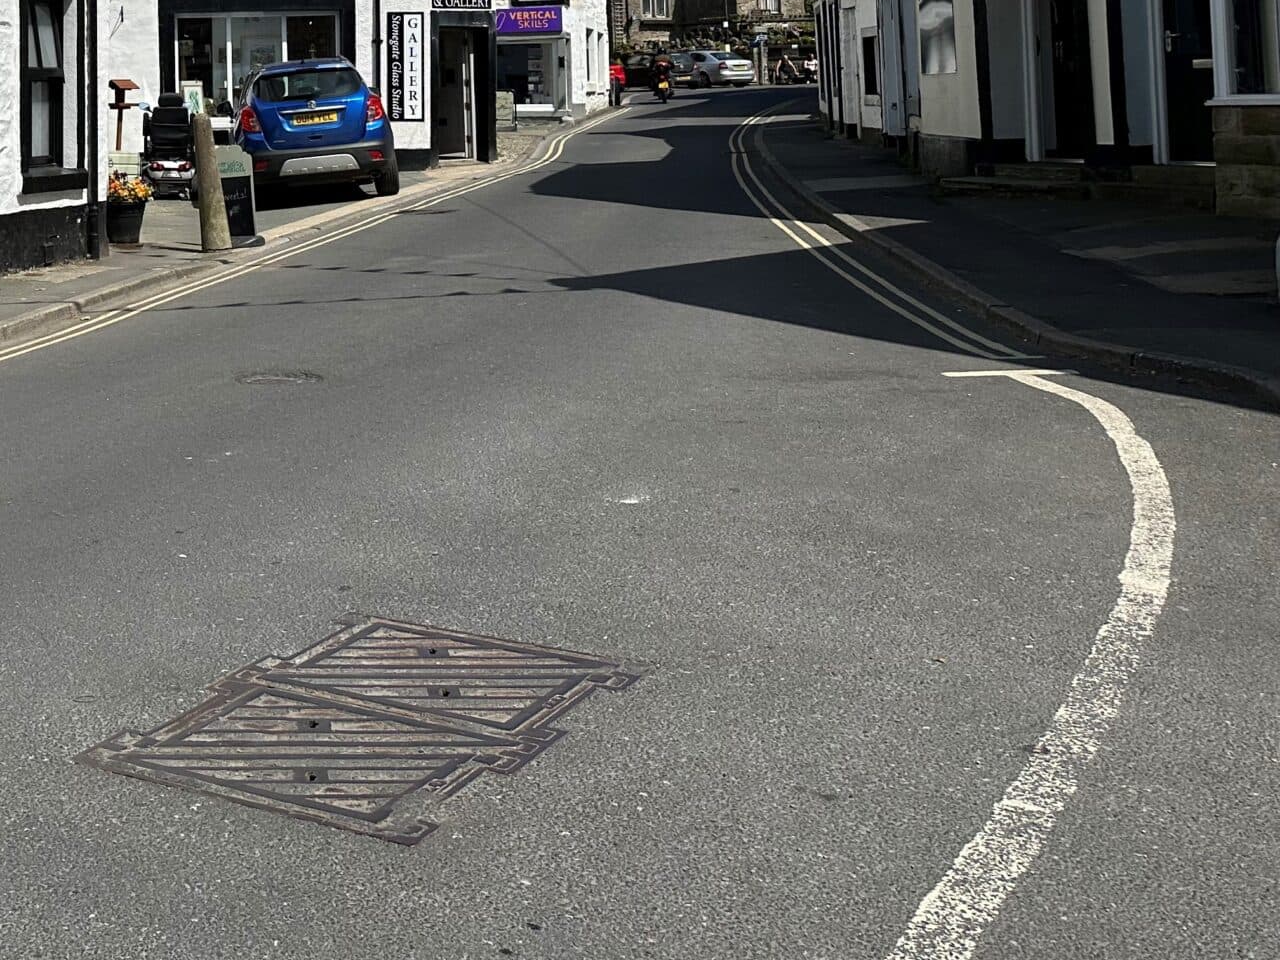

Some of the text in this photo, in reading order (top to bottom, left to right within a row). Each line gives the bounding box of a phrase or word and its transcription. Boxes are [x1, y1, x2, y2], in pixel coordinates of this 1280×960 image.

[388, 14, 402, 119] Stonegate Glass Studio
[407, 17, 419, 116] GALLERY
[518, 19, 549, 29] SKILLS
